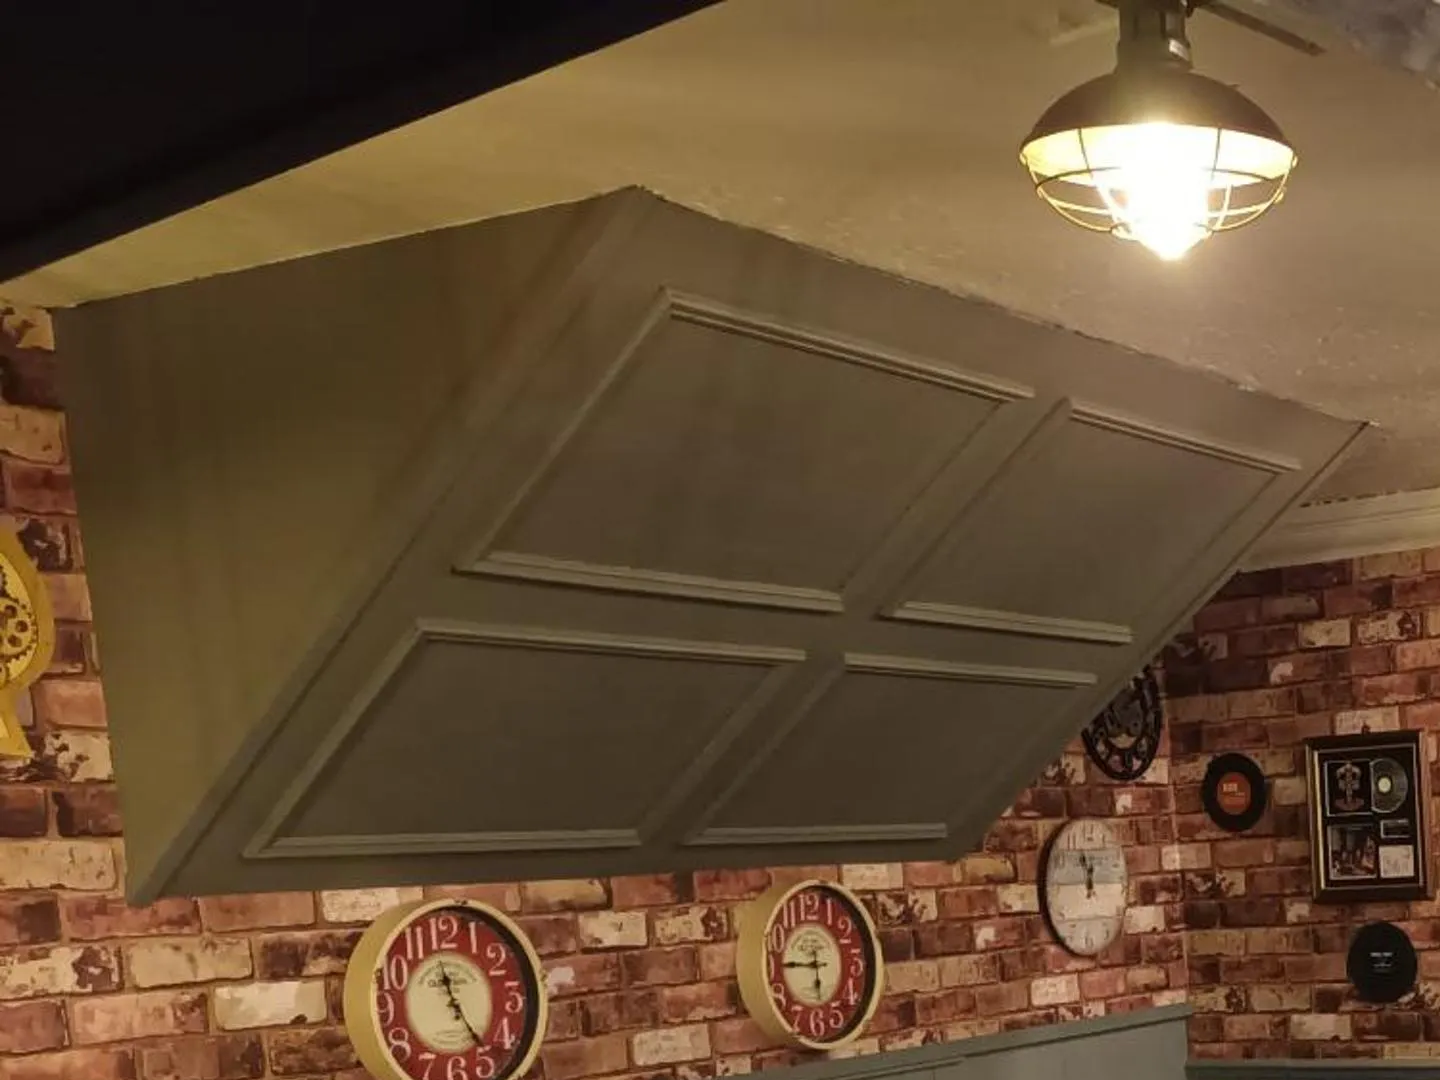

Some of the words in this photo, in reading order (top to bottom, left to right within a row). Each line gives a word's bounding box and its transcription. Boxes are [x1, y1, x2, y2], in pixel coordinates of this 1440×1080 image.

[799, 893, 819, 921] 12
[826, 898, 833, 926] 1
[405, 926, 424, 960] 11
[429, 917, 459, 950] 12
[468, 921, 479, 954] 1
[838, 917, 852, 944] 2
[382, 955, 408, 990] 10
[487, 943, 507, 977] 2
[850, 949, 863, 976] 3
[504, 981, 524, 1013] 3
[842, 977, 859, 1006] 4
[791, 1005, 804, 1033] 7
[810, 1009, 825, 1037] 6
[829, 1001, 844, 1028] 5
[388, 1027, 411, 1063] 8
[493, 1017, 516, 1050] 4
[475, 1045, 495, 1079] 5
